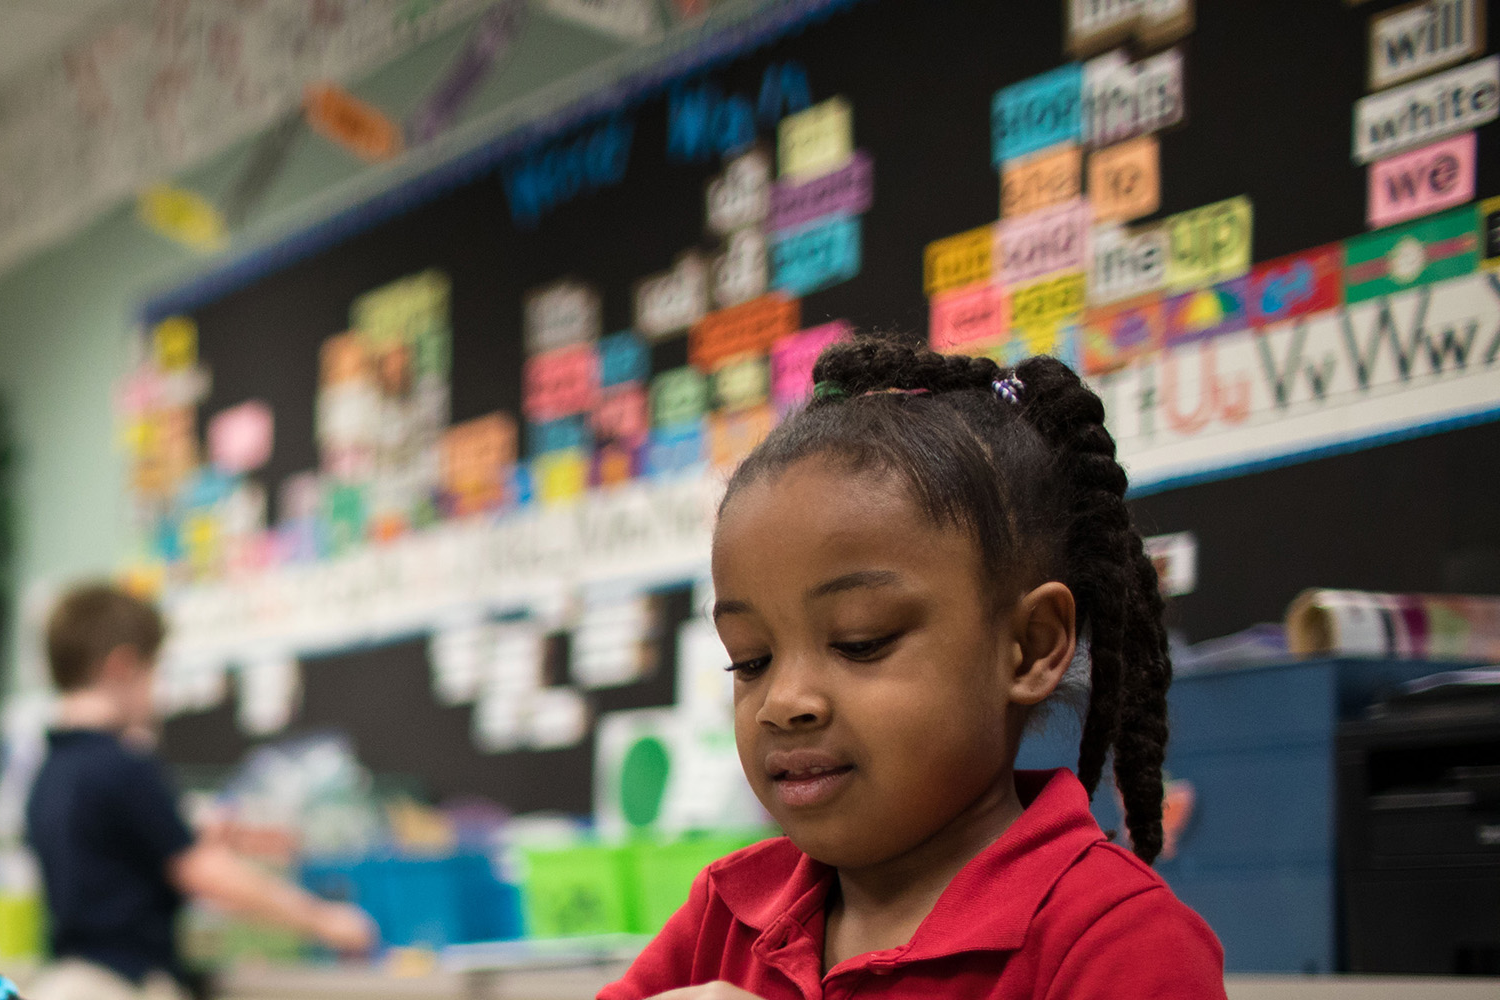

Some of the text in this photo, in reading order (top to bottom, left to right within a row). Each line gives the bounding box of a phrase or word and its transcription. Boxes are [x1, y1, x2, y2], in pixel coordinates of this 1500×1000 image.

[1386, 1, 1463, 66] will
[1369, 81, 1498, 143] white
[1385, 153, 1460, 202] we
[1171, 208, 1241, 274] up
[1338, 284, 1480, 391] Ww
